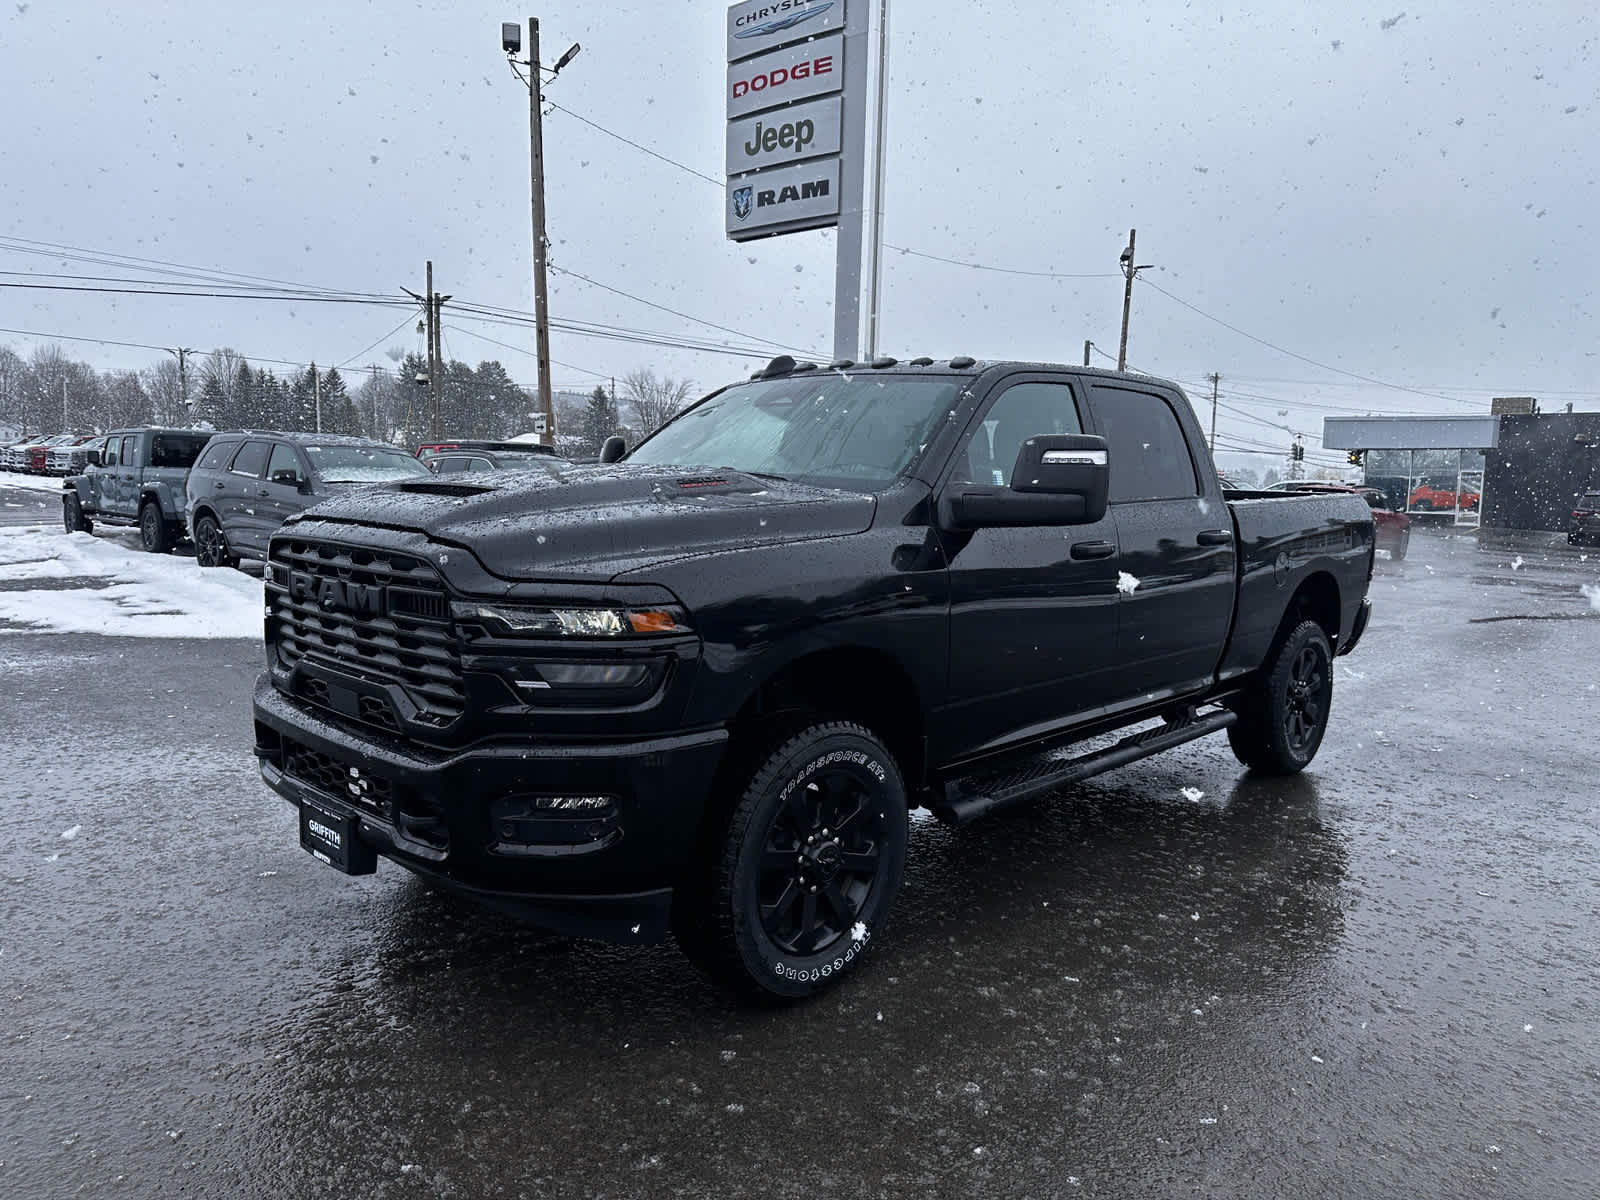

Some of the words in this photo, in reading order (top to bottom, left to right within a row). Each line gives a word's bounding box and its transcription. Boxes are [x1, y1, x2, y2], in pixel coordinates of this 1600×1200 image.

[733, 56, 833, 98] DODGE
[744, 118, 814, 156] Jeep
[757, 179, 830, 207] RAM
[290, 570, 382, 615] RAM
[780, 750, 867, 801] TRANSFORCE
[309, 819, 341, 845] GRIFFITH
